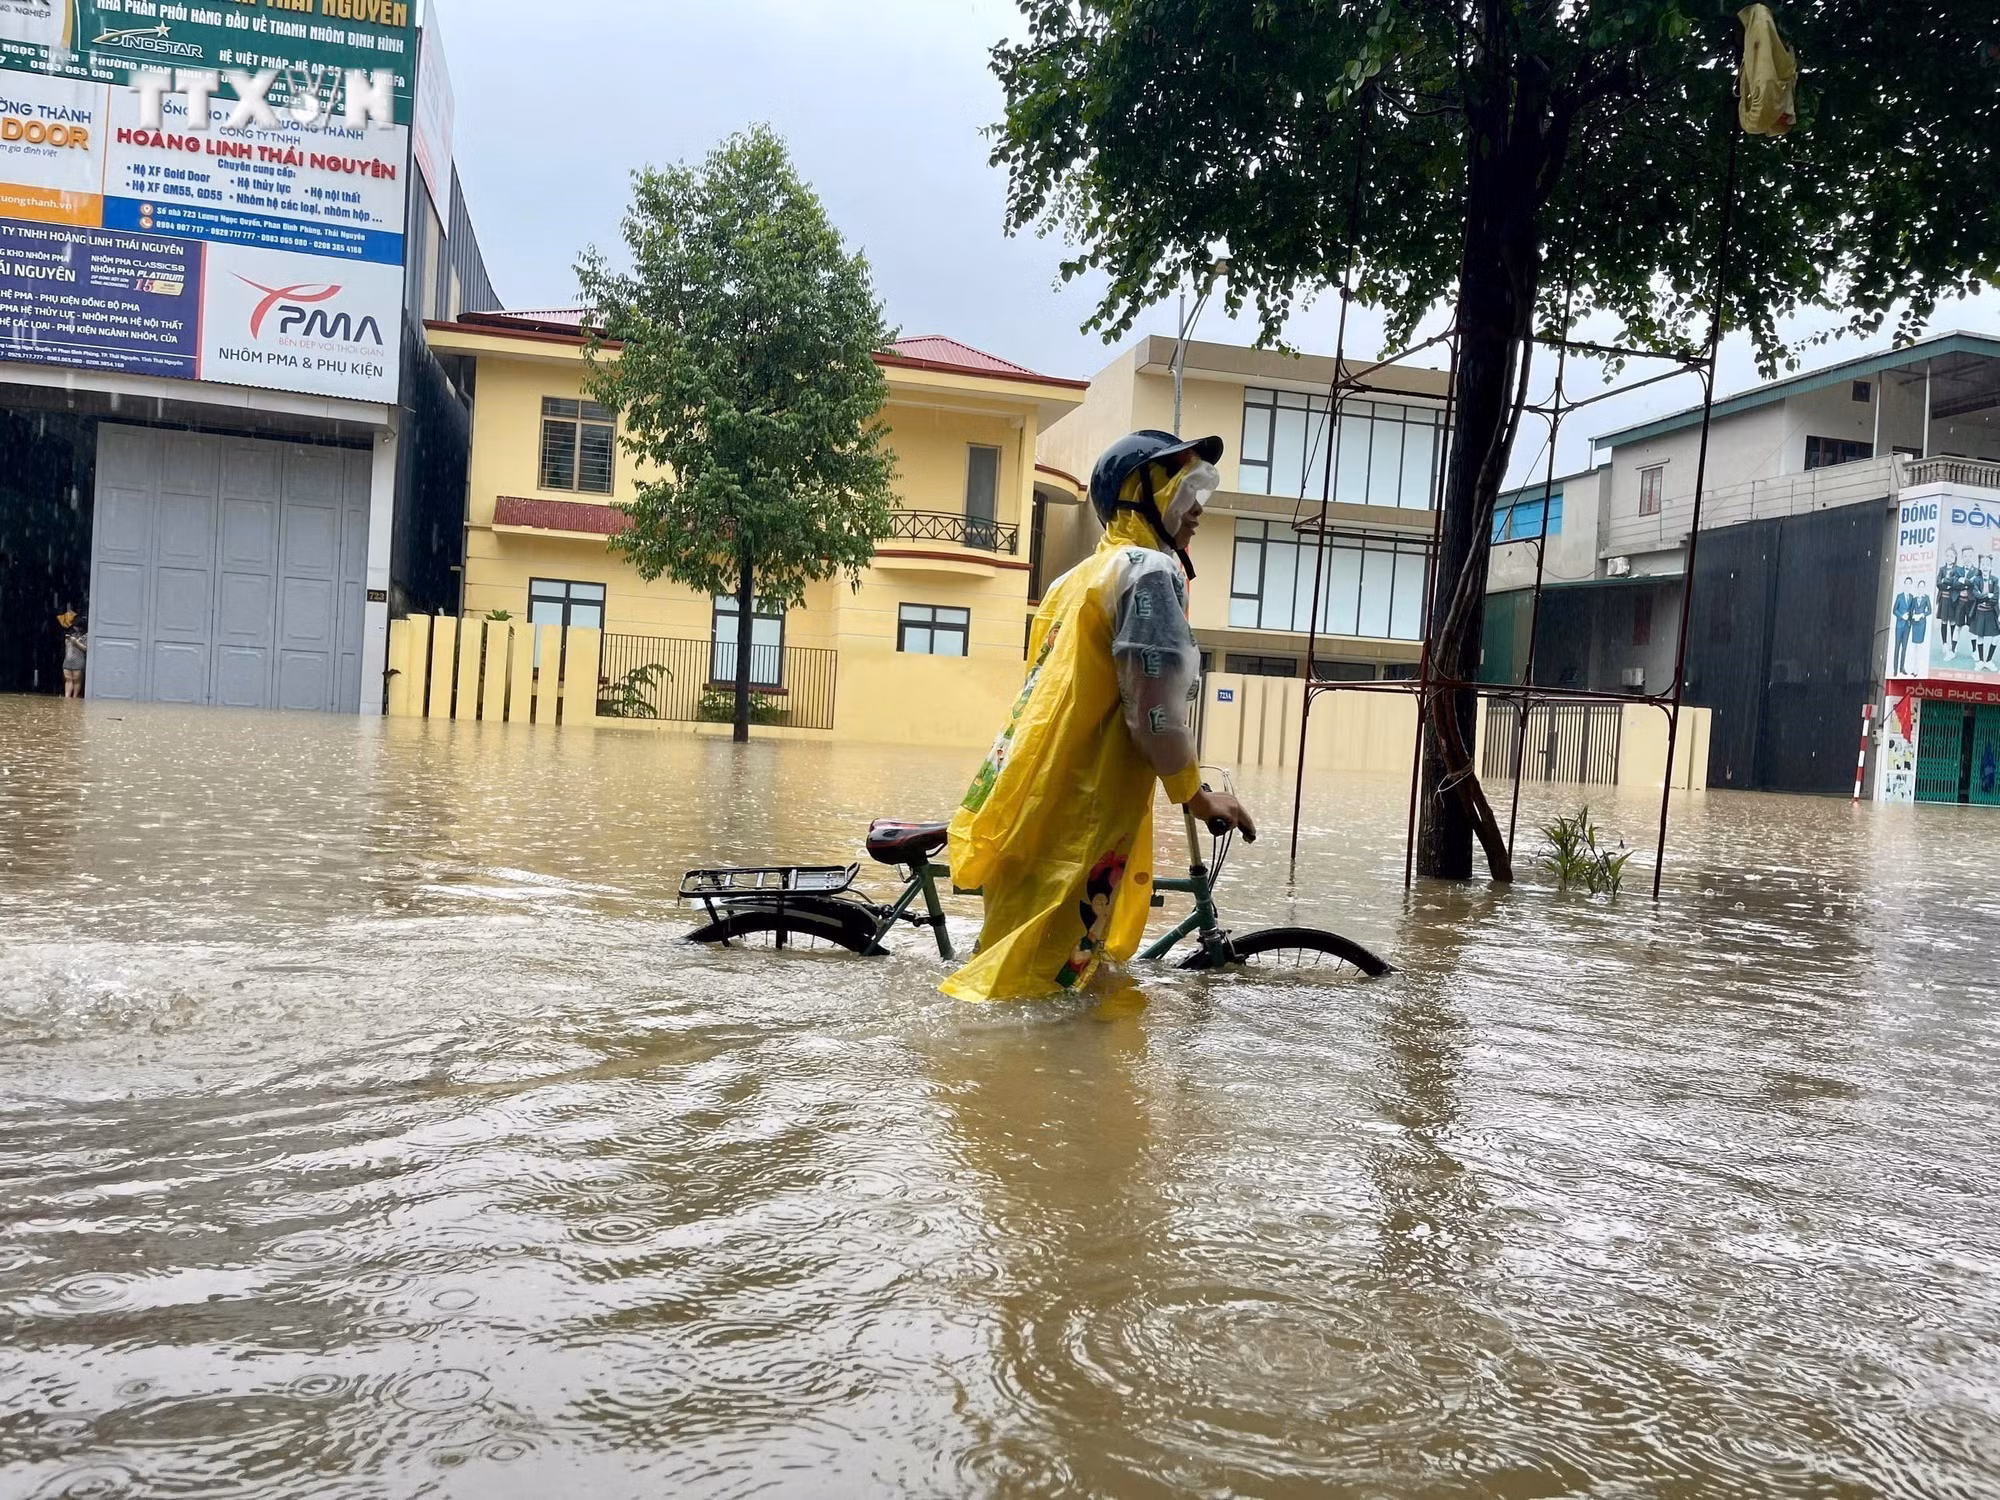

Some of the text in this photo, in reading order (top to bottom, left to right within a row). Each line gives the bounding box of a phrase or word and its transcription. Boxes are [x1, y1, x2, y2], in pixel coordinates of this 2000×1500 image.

[14, 6, 51, 19] NGHIỆP
[162, 3, 187, 20] PHỐI
[191, 7, 222, 26] HÀNG
[225, 10, 249, 30] ĐẦU
[252, 13, 267, 33] VỀ
[269, 19, 307, 39] THANH
[310, 26, 345, 45] NHÔM
[347, 32, 374, 49] ĐỊNH
[377, 34, 404, 53] HÌNH
[103, 27, 204, 58] DINOSTAR
[2, 43, 36, 57] NGỌC
[90, 56, 137, 71] PHƯỜNG
[219, 49, 233, 65] HỆ
[235, 51, 258, 67] VIỆT
[328, 65, 341, 78] 55
[65, 65, 88, 76] 065
[38, 105, 91, 123] THÀNH
[1, 116, 90, 150] DOOR
[257, 130, 270, 140] TY
[270, 132, 301, 145] TNHH
[322, 125, 364, 140] THÀNH
[8, 144, 59, 158] gia đình Việt
[117, 127, 396, 180] HOÀNG LINH THÁI NGUYÊN
[133, 164, 211, 183] Hệ XF Gold Door
[218, 158, 251, 172] Chuyên
[253, 165, 275, 177] cung
[132, 180, 145, 193] Hệ
[147, 182, 160, 193] XF
[197, 188, 223, 201] GD55
[237, 177, 291, 195] Hệ thủy lực
[310, 187, 361, 204] Hệ nội thất
[236, 193, 264, 206] Nhôm
[266, 197, 278, 210] hệ
[281, 198, 298, 212] các
[324, 206, 350, 218] nhôm
[353, 210, 370, 223] hộp
[183, 209, 196, 218] 723
[264, 219, 281, 229] Phan
[324, 228, 339, 238] Thái
[340, 230, 366, 241] Nguyên
[1, 225, 184, 255] TY TNHH HOÀNG LINH THÁI NGUYÊN
[7, 249, 70, 263] KHO NHÔM PMA
[91, 254, 185, 272] NHÔM PMA CLASSIC58
[14, 264, 76, 282] NGUYÊN
[90, 265, 116, 275] NHÔM
[117, 267, 135, 277] PMA
[1, 288, 13, 300] HỆ
[14, 291, 33, 301] PMA
[40, 293, 58, 304] PHỤ
[60, 294, 80, 306] KIỆN
[107, 299, 119, 311] BỘ
[121, 302, 140, 312] PMA
[0, 304, 184, 331] PMA HỆ THỦY LỰC NHÔM PMA HỆ NỘI THẤT
[278, 305, 383, 346] PMA
[0, 317, 11, 327] HỆ
[12, 318, 30, 328] CÁC
[31, 320, 50, 332] LOẠI
[57, 324, 75, 334] PHỤ
[76, 324, 97, 336] KIỆN
[98, 326, 129, 338] NGÀNH
[160, 332, 178, 343] CỬA
[360, 347, 384, 357] GIAN
[219, 347, 383, 378] NHÔM PMA & PHỤ KIỆN
[1901, 500, 1938, 524] ĐỒNG
[1900, 527, 1935, 548] PHỤC
[369, 592, 385, 600] 723
[1948, 689, 1983, 702] PHỤC
